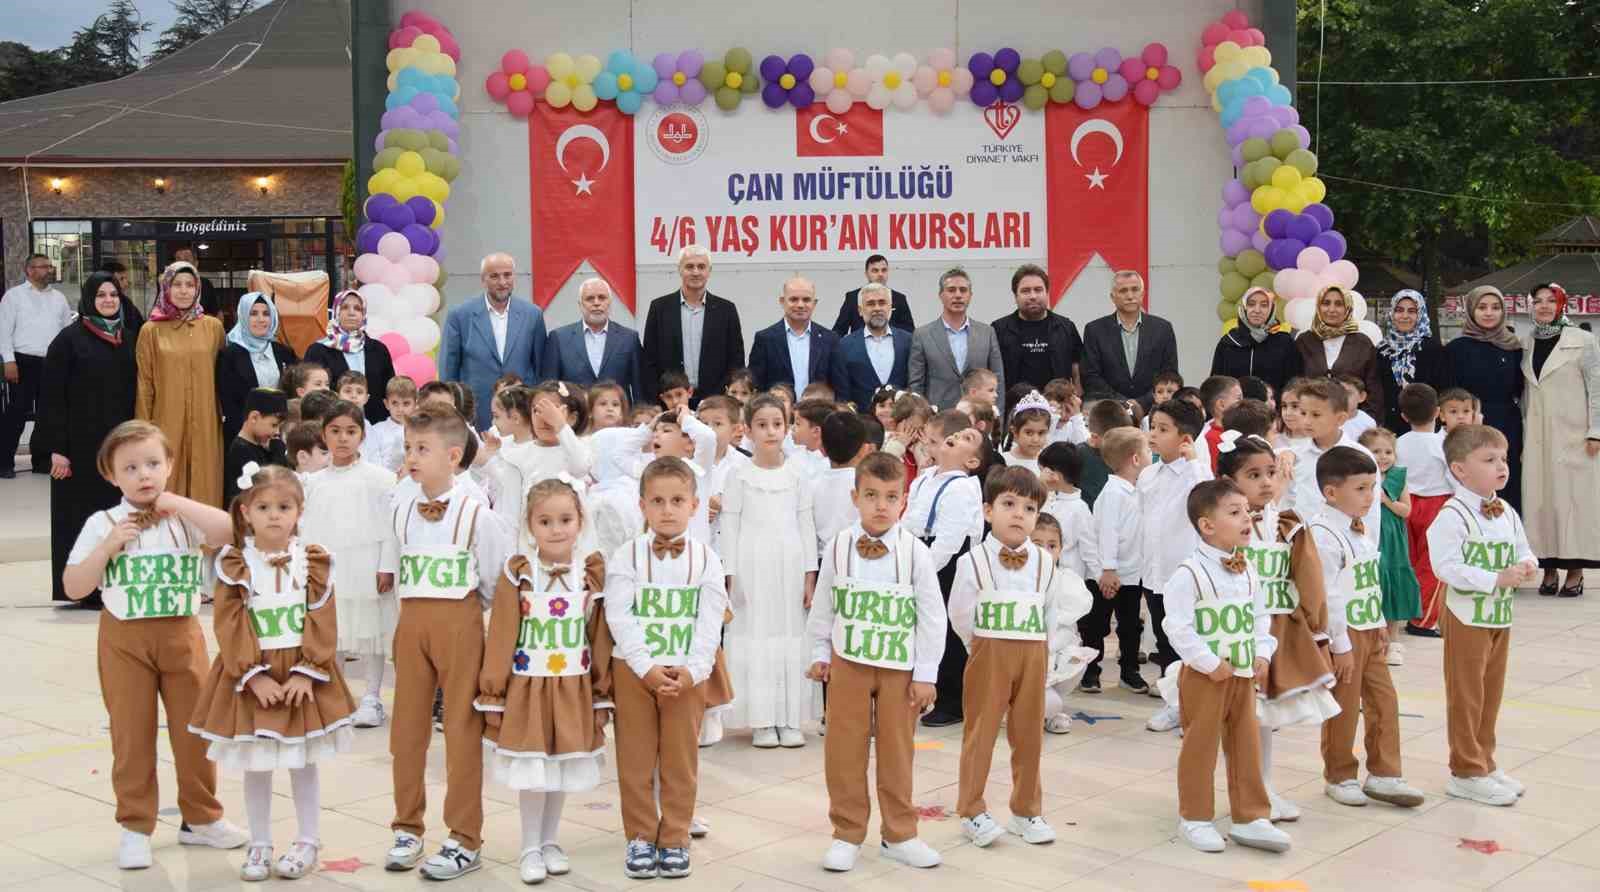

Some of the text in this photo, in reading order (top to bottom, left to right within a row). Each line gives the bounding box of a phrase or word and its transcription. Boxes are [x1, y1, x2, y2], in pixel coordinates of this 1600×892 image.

[728, 165, 953, 205] ÇAN MÜFTÜLÜĞÜ
[174, 219, 248, 235] Hoşgeldiniz
[650, 211, 1031, 257] 4/6 YAŞ KUR'AN KURSLARI
[125, 584, 198, 618] MET
[843, 624, 909, 663] LÜK
